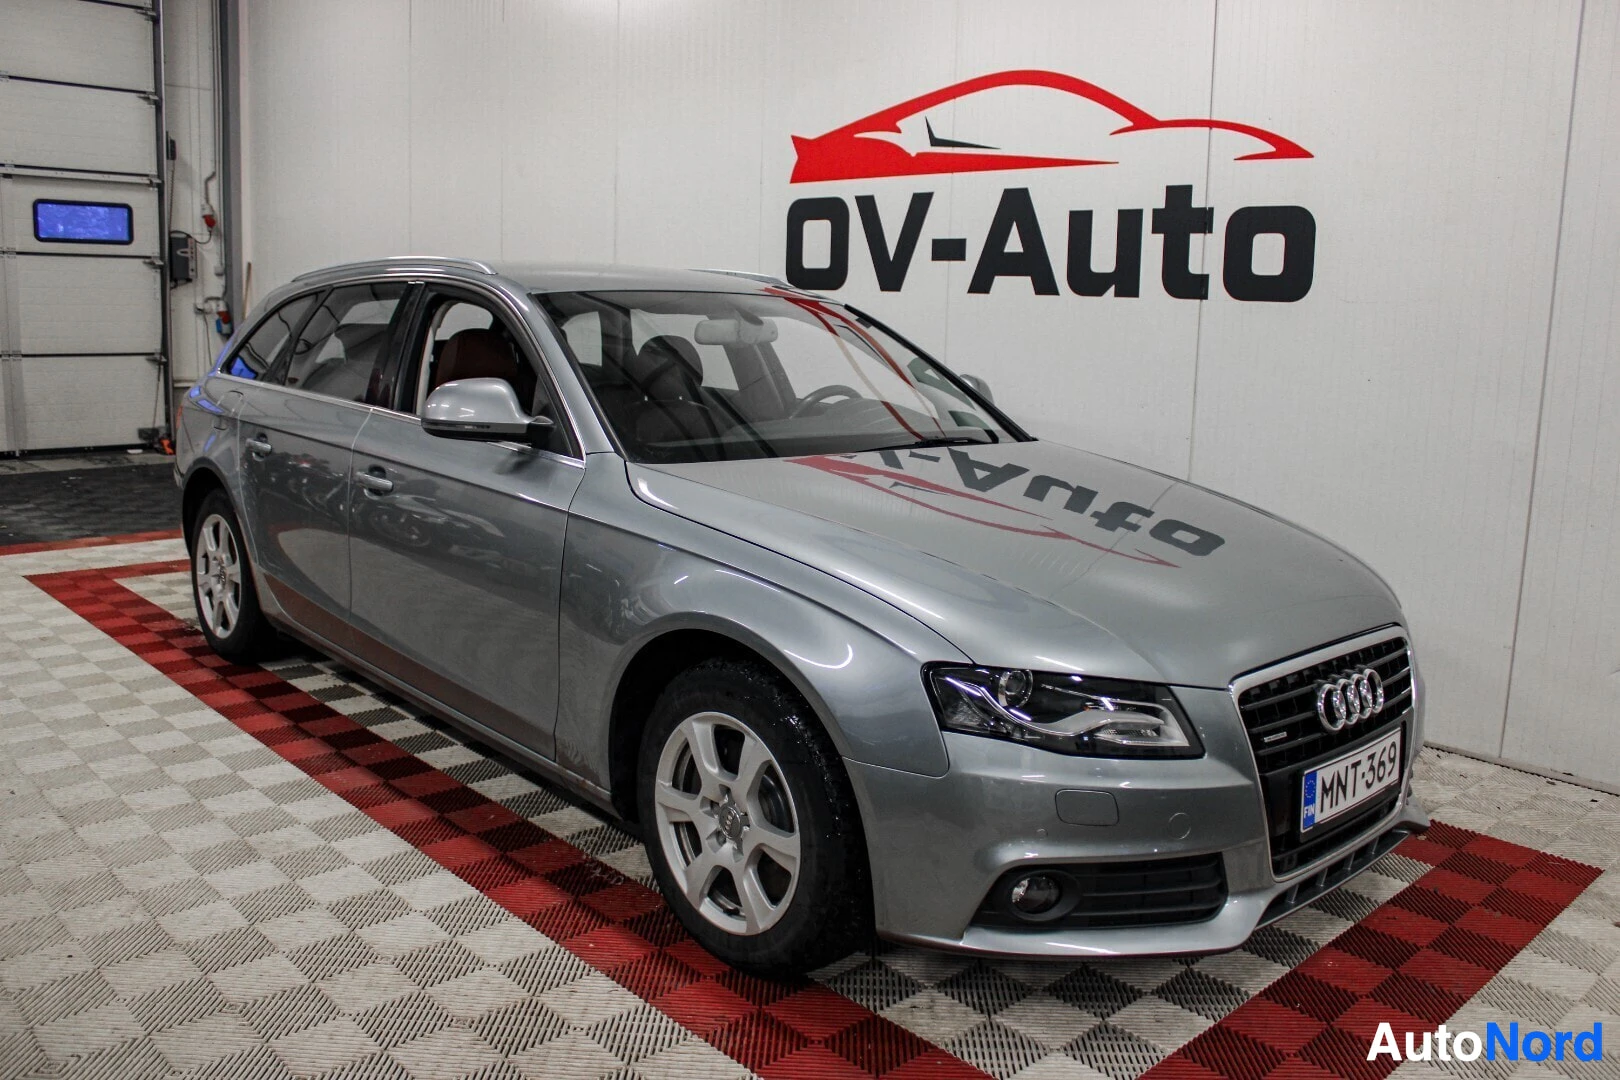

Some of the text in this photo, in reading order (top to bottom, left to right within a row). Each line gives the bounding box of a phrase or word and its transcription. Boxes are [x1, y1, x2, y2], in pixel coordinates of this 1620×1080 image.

[786, 184, 1316, 302] OV-Auto
[1303, 803, 1315, 818] FIN
[1320, 741, 1397, 813] MNT-369
